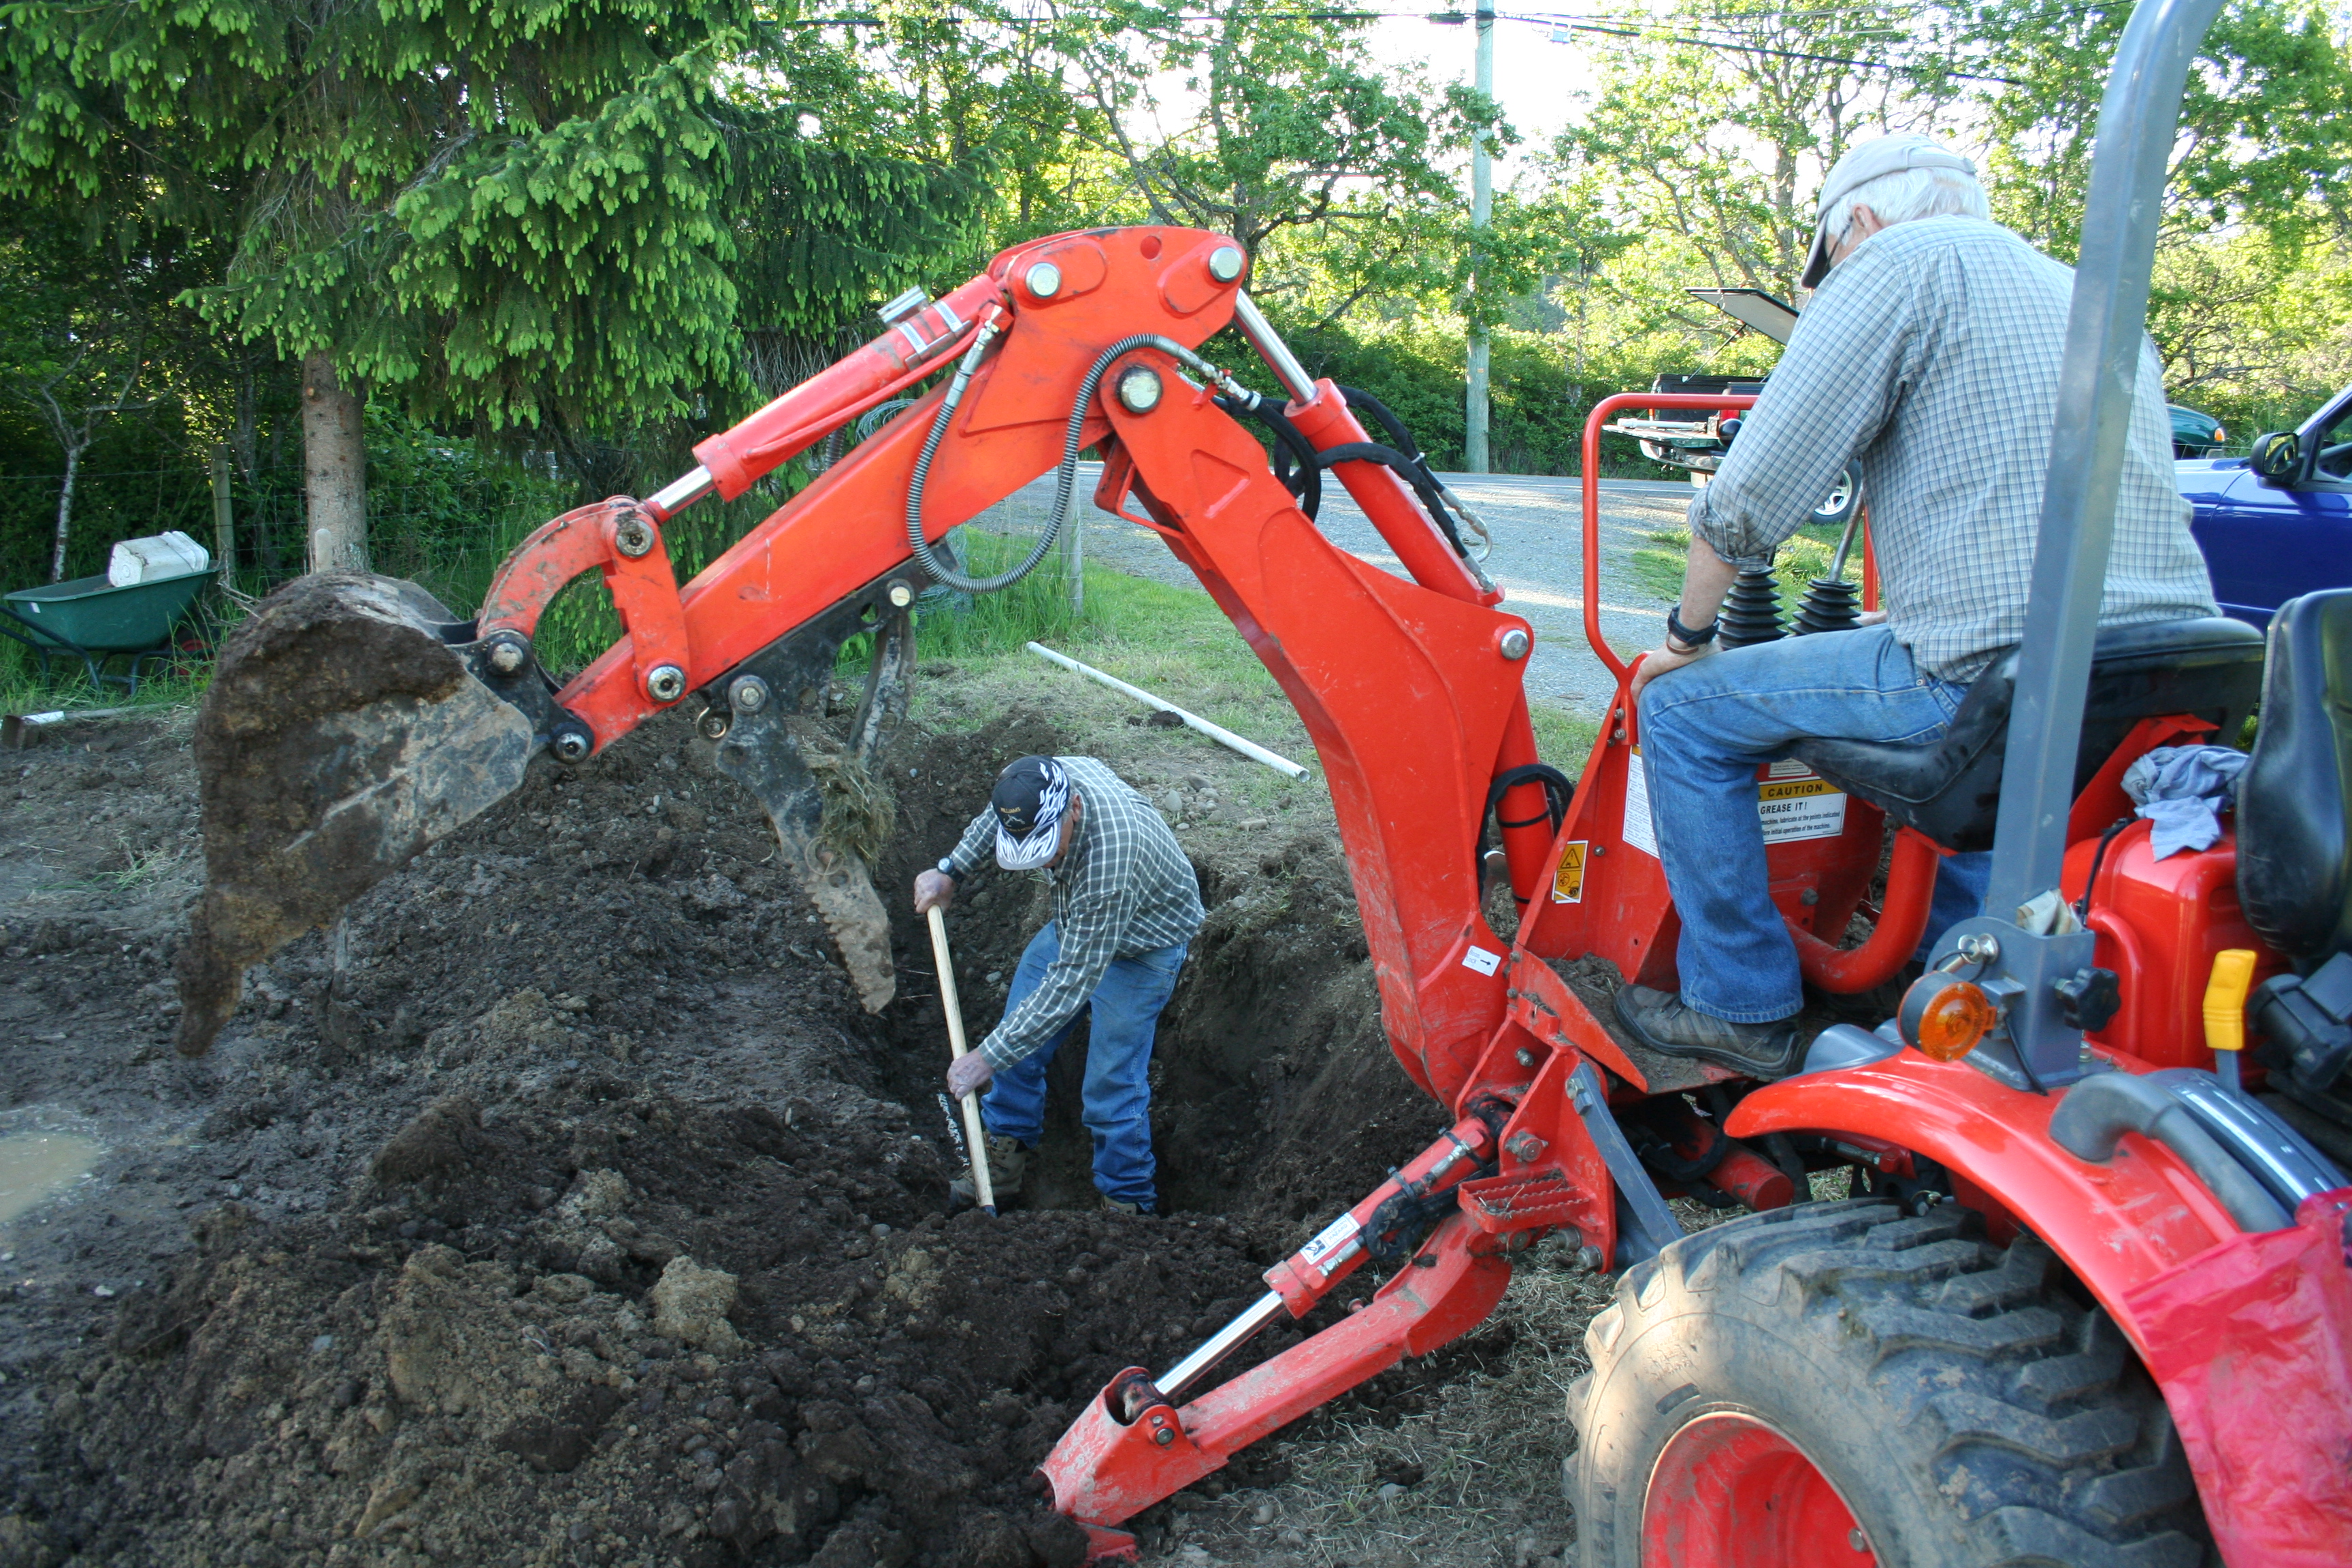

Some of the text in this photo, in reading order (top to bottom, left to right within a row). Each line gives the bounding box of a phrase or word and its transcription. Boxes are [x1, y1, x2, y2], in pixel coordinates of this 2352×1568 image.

[1767, 783, 1823, 797] CAUTION
[1760, 803, 1791, 815] GREASE
[1328, 1223, 1348, 1241] HAZARD
